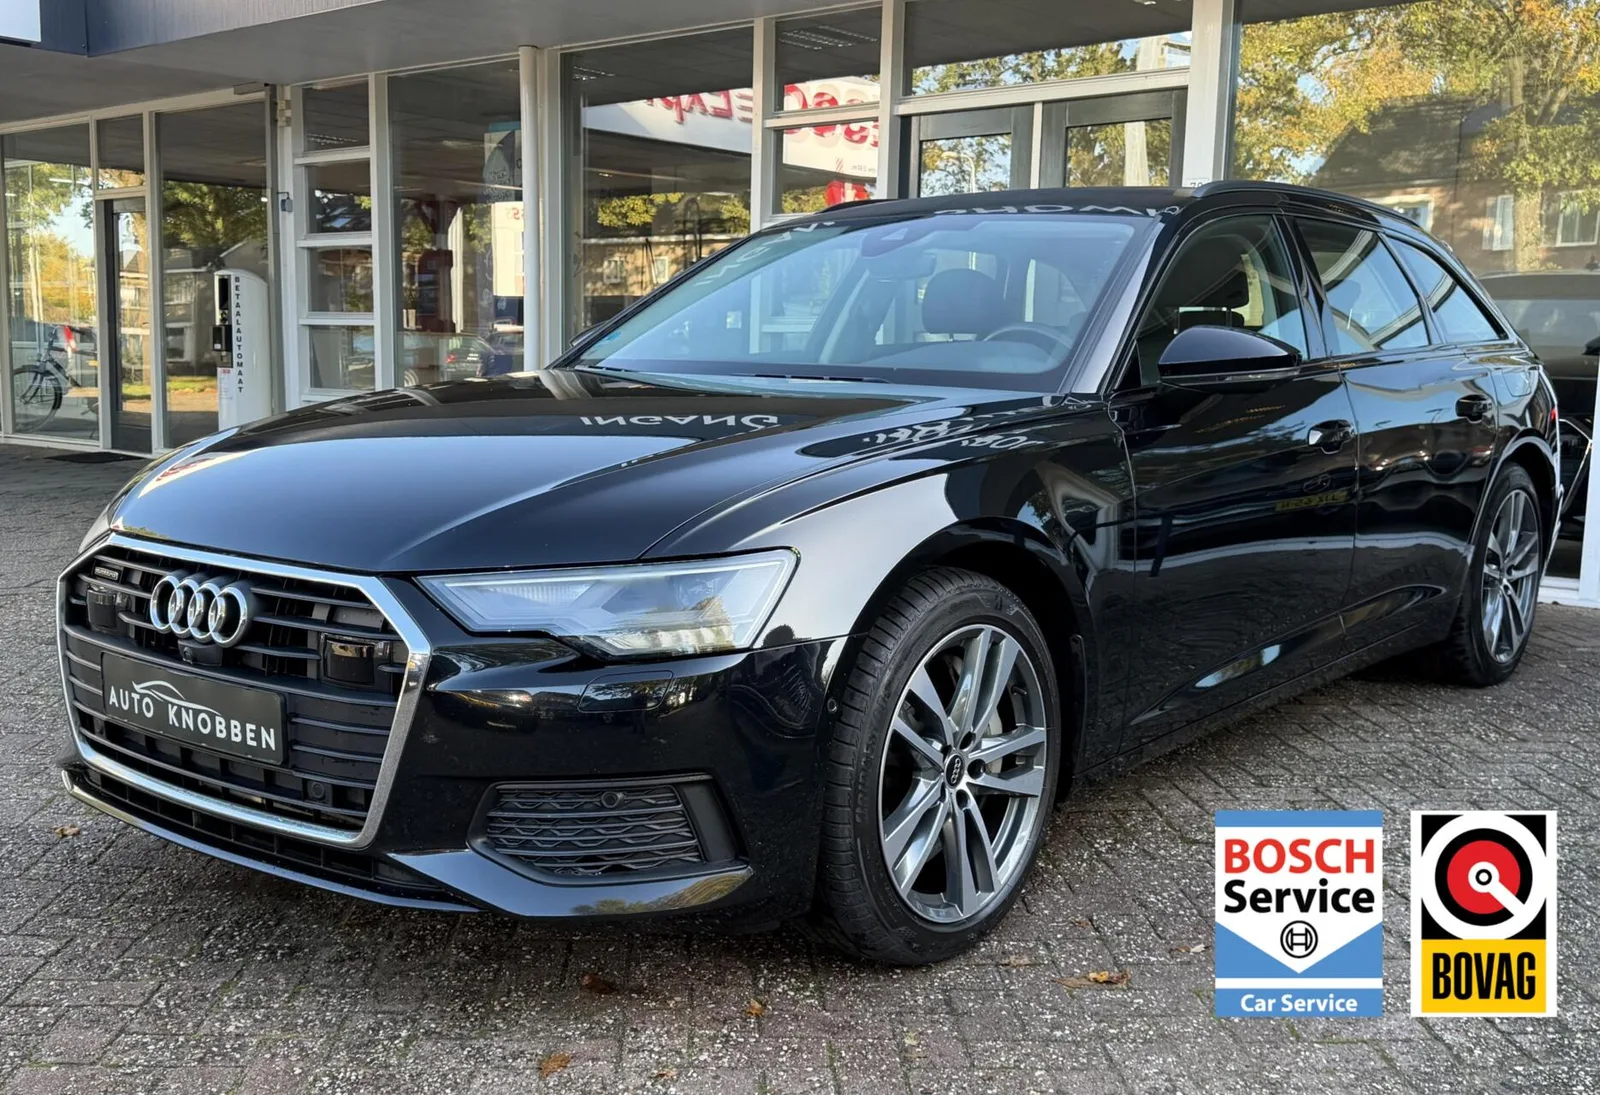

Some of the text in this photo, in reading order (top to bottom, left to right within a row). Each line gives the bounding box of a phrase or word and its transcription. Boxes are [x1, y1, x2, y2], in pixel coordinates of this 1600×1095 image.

[234, 276, 244, 393] BETAALAUTOMAAT
[109, 685, 276, 750] AUTO KNOBBEN
